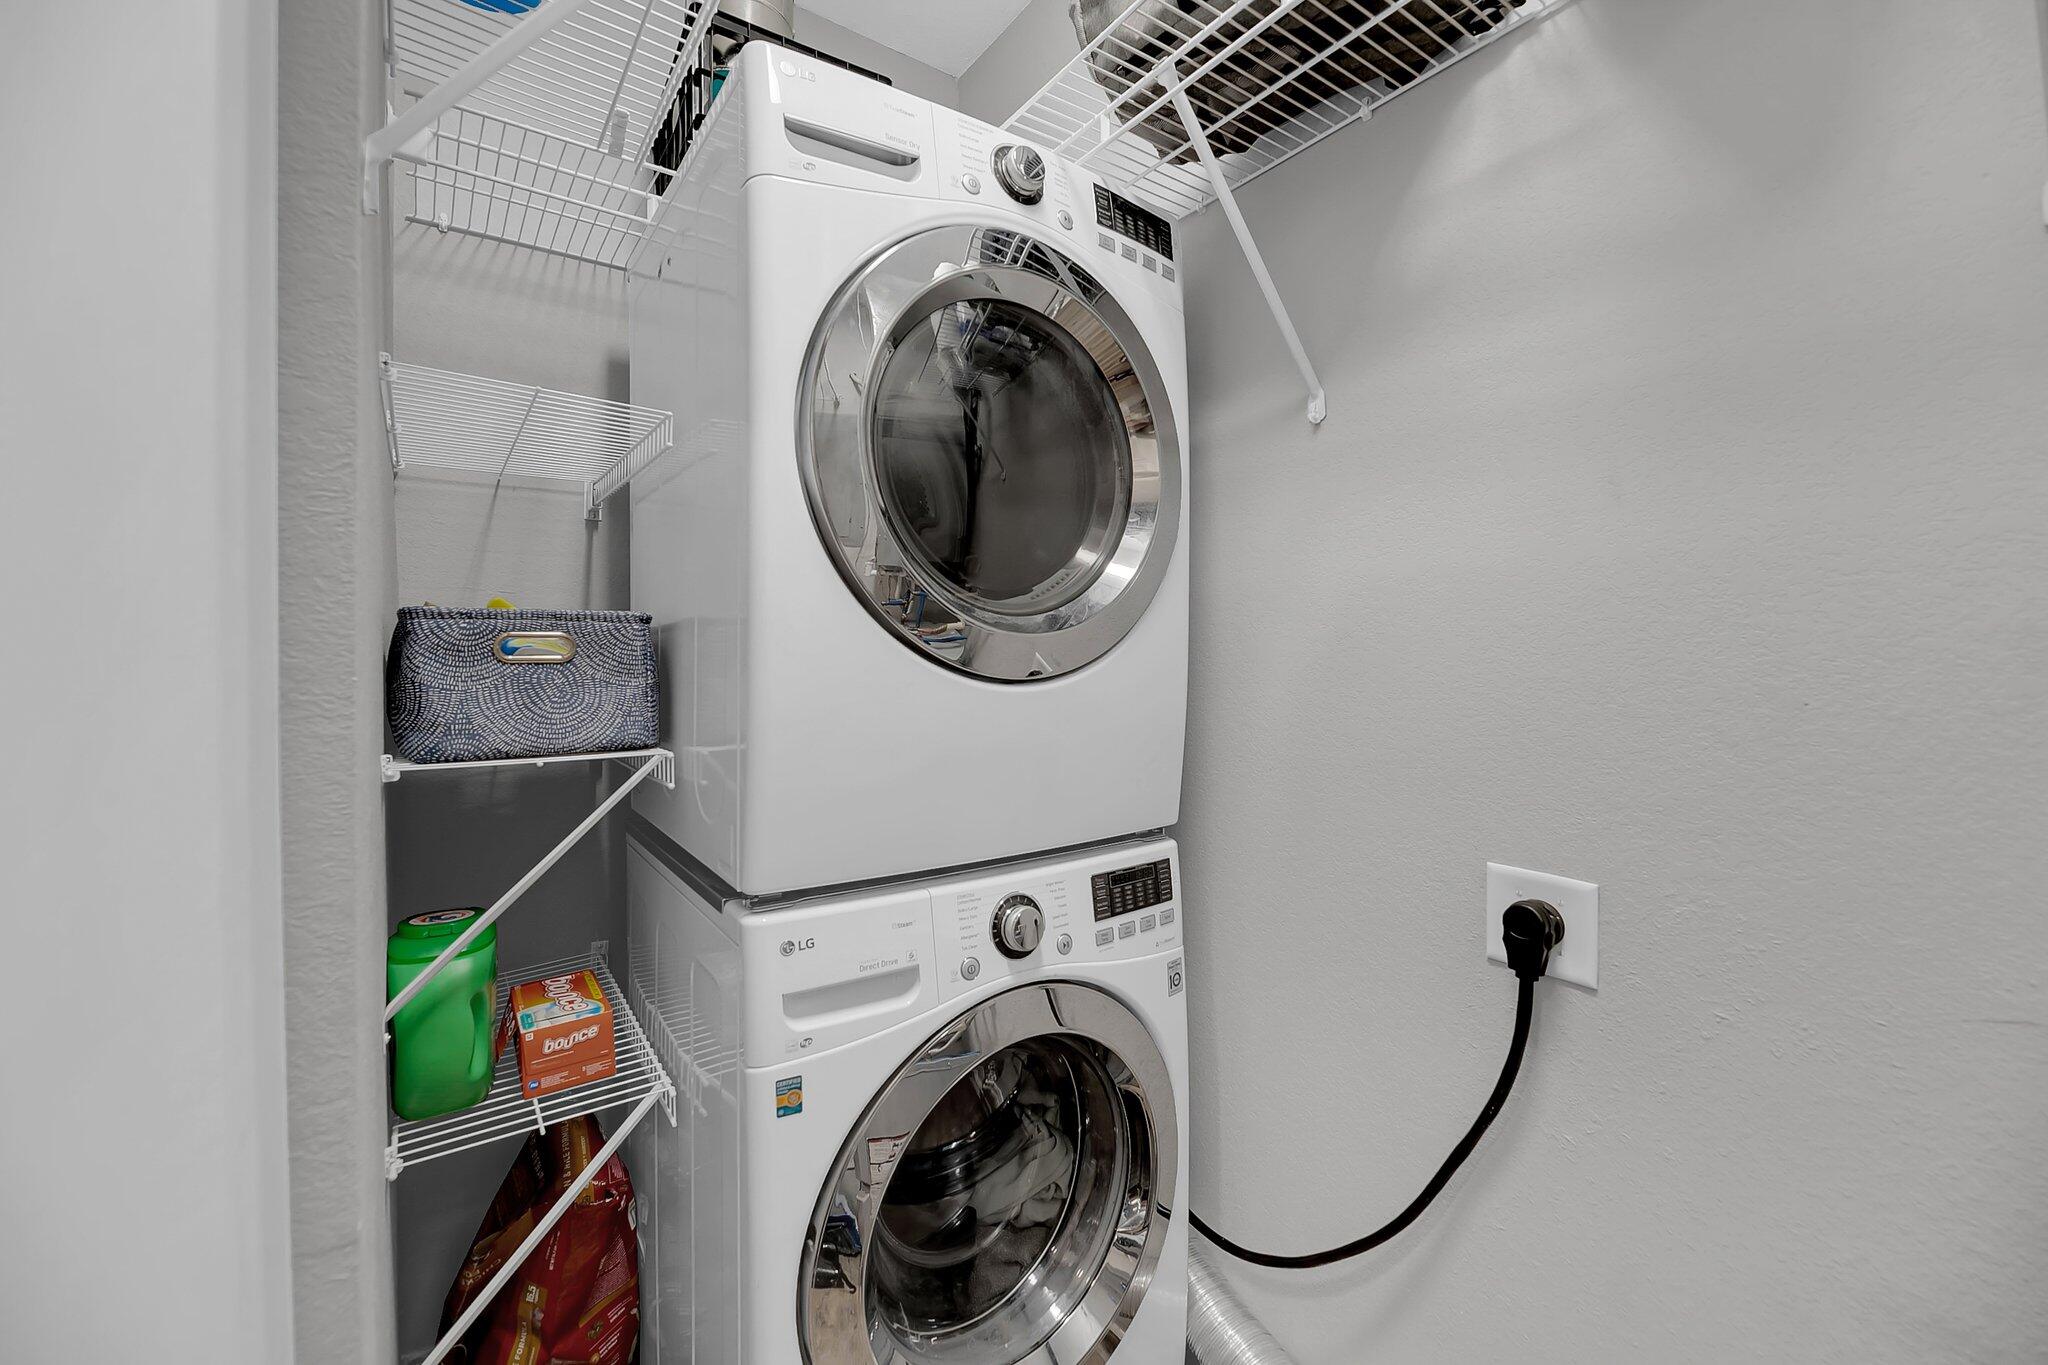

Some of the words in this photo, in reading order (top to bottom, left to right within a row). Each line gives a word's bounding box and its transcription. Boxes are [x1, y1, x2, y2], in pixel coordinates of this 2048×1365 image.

[798, 937, 815, 951] LG
[859, 962, 880, 973] Direct
[881, 958, 899, 968] Drive
[542, 1024, 600, 1054] bounce
